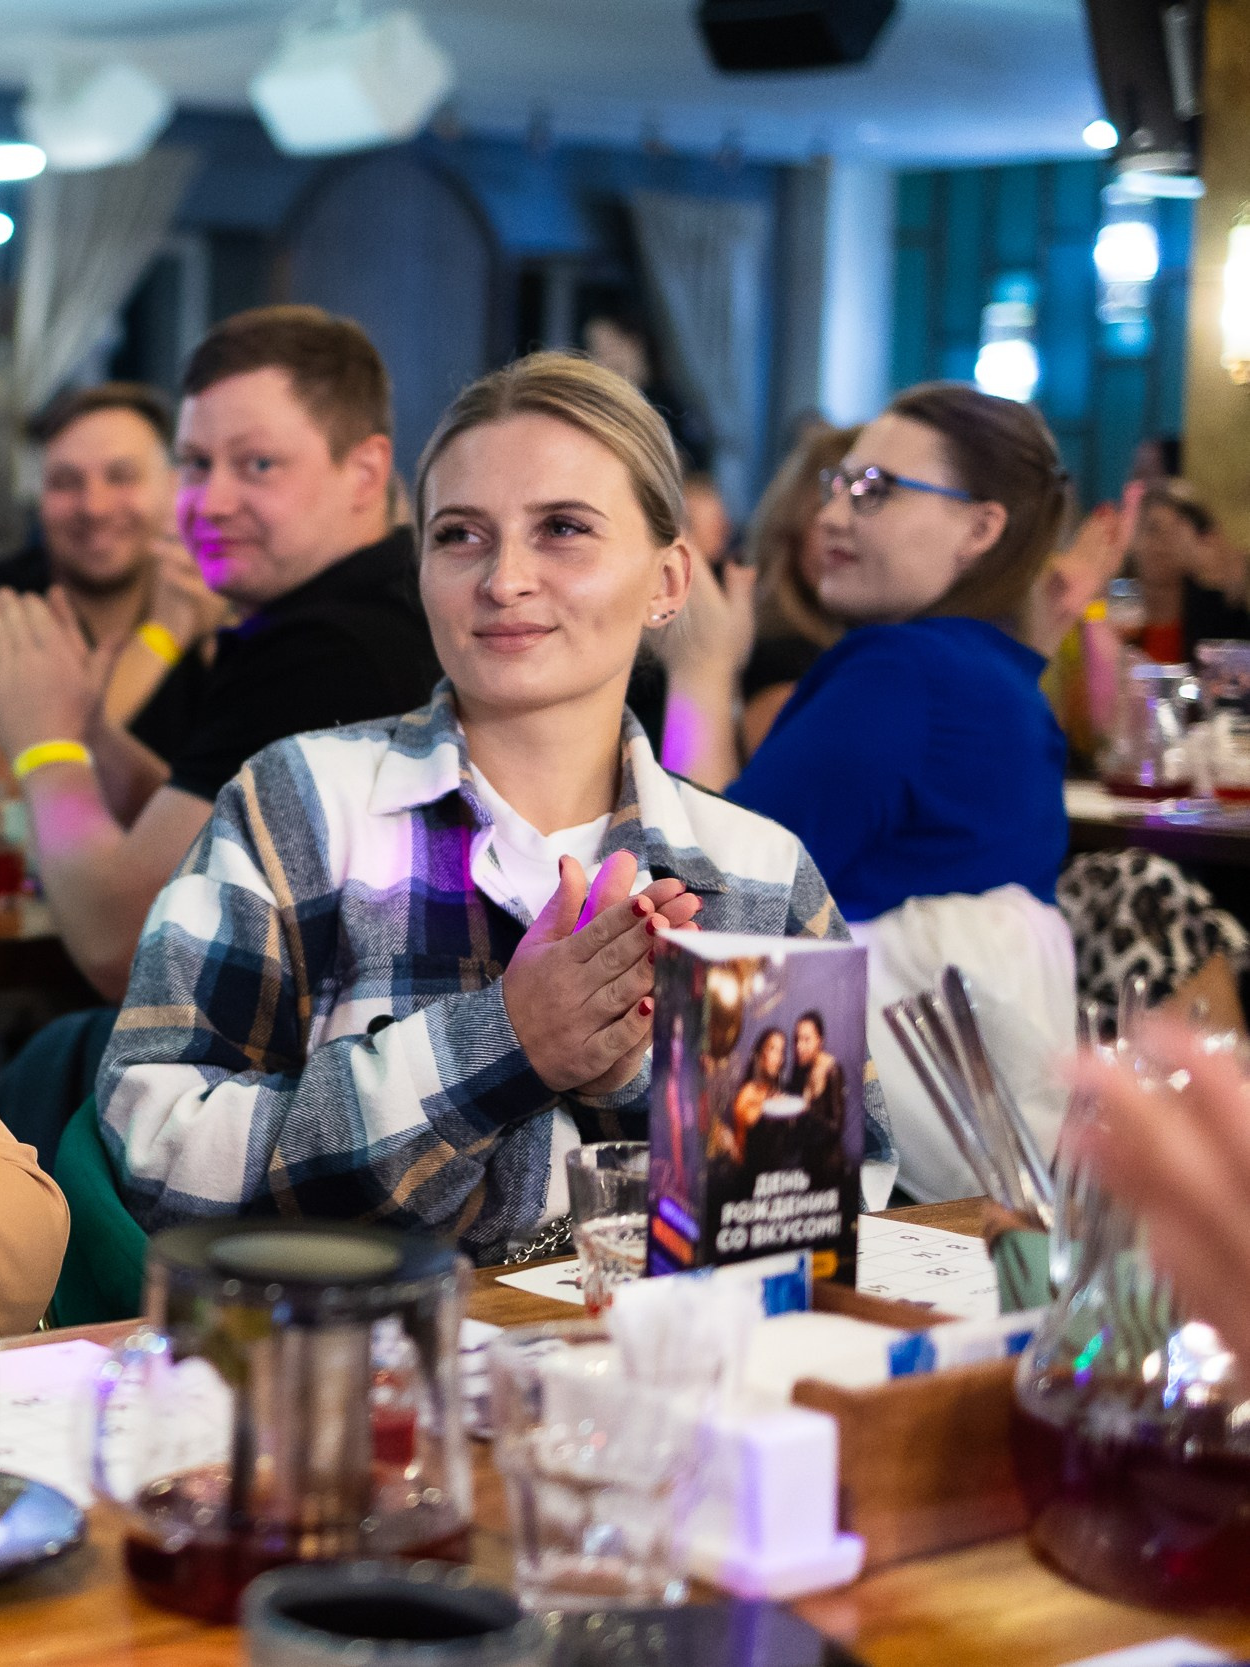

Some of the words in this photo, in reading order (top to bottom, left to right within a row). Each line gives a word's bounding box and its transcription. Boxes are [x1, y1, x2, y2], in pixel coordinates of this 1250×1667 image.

[753, 1170, 811, 1200] ДЕНЬ
[721, 1188, 839, 1227] РОЖДЕНИЯ
[716, 1226, 749, 1254] СО
[750, 1212, 841, 1248] ВКУСОМ!
[926, 1267, 959, 1276] 28
